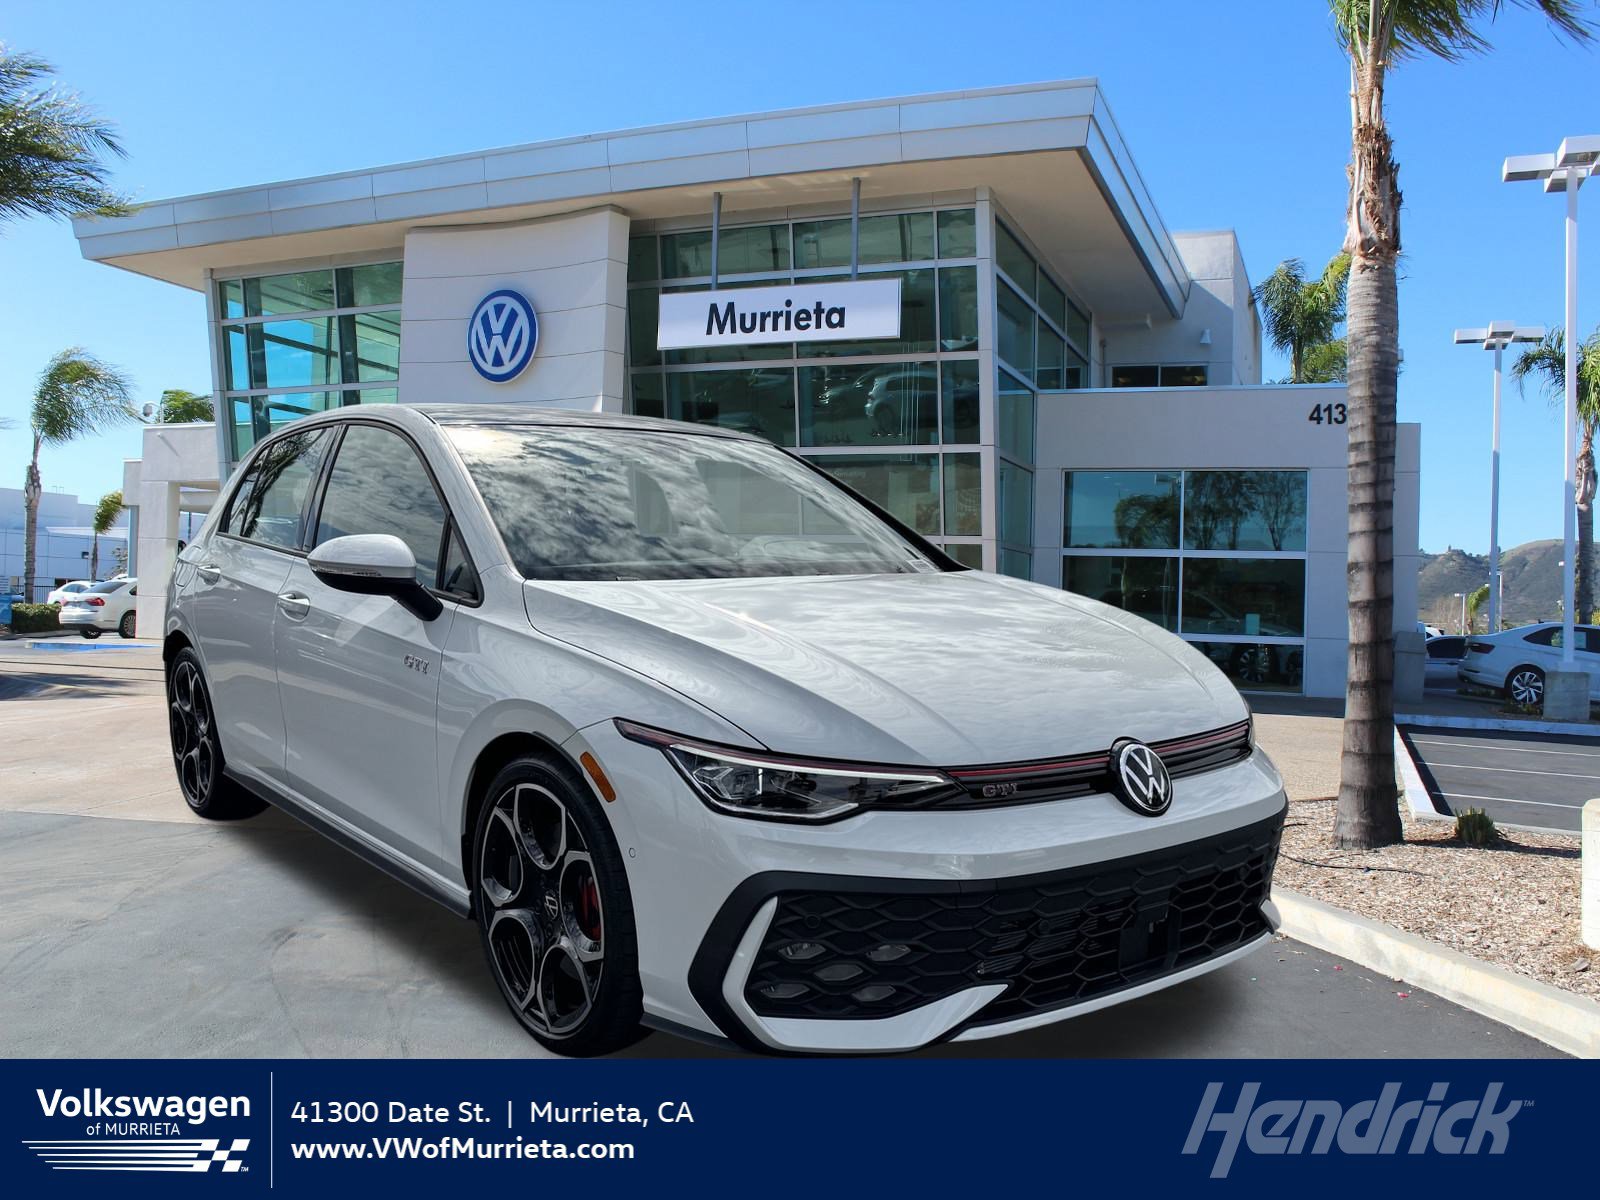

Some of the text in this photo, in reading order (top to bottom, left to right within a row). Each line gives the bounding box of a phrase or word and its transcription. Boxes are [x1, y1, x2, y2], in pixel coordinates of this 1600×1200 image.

[706, 299, 846, 335] Murrieta
[469, 297, 533, 374] VW
[1308, 403, 1347, 425] 413
[403, 654, 430, 674] GTI
[982, 783, 1018, 798] GTI
[1118, 742, 1172, 812] VW
